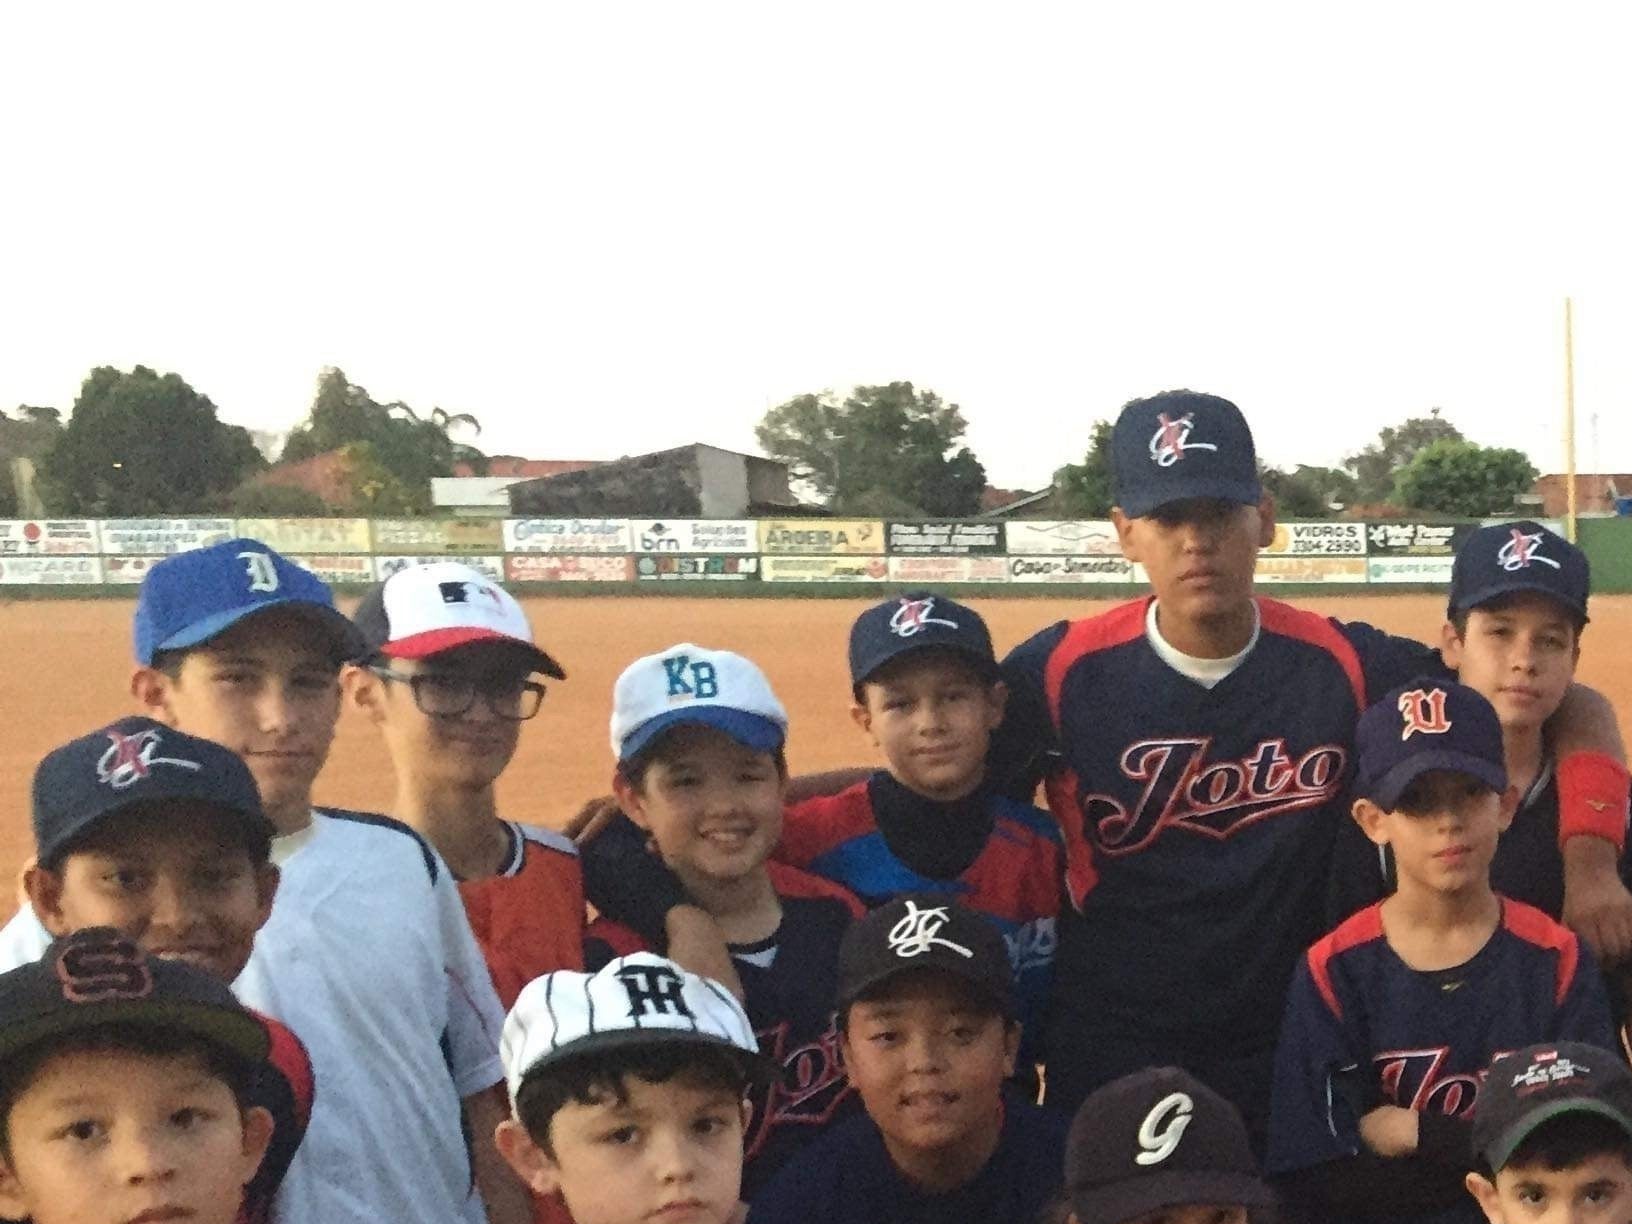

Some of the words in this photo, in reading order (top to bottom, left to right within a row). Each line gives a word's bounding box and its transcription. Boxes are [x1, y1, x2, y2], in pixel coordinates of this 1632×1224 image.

[765, 530, 848, 545] AROEIRA
[1293, 526, 1357, 537] VIDROS
[512, 556, 562, 569] CASA
[663, 657, 719, 700] KB
[1398, 687, 1453, 742] U
[57, 934, 154, 1002] S
[1134, 1092, 1193, 1165] G
